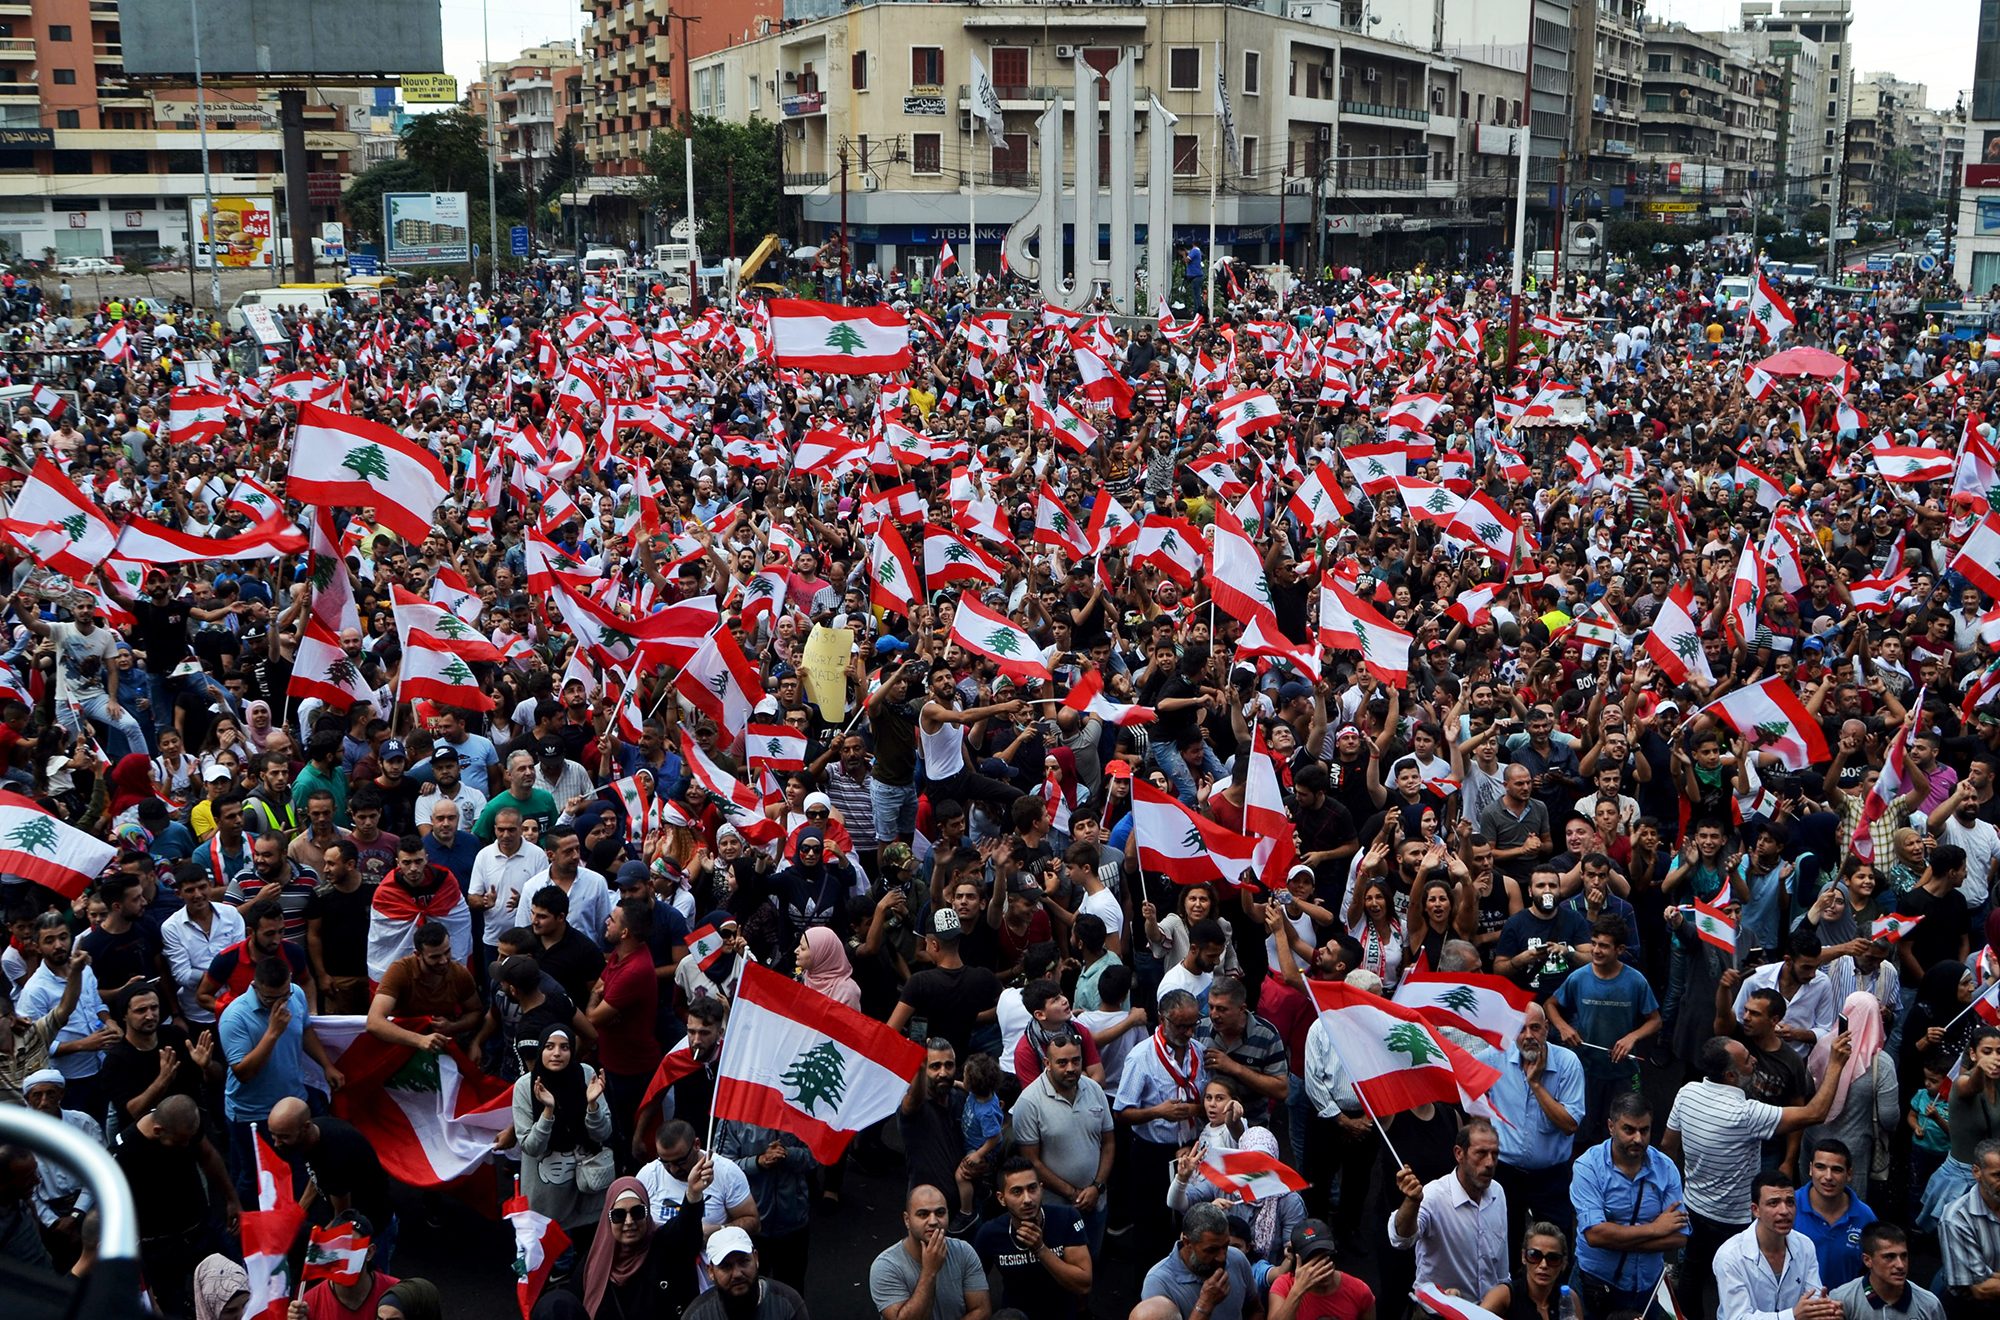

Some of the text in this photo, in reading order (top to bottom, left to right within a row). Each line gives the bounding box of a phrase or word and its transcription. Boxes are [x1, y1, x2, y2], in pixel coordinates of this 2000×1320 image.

[402, 76, 454, 86] Nouvo Pano
[229, 114, 272, 122] Foundation
[999, 1253, 1028, 1266] DESIGN
